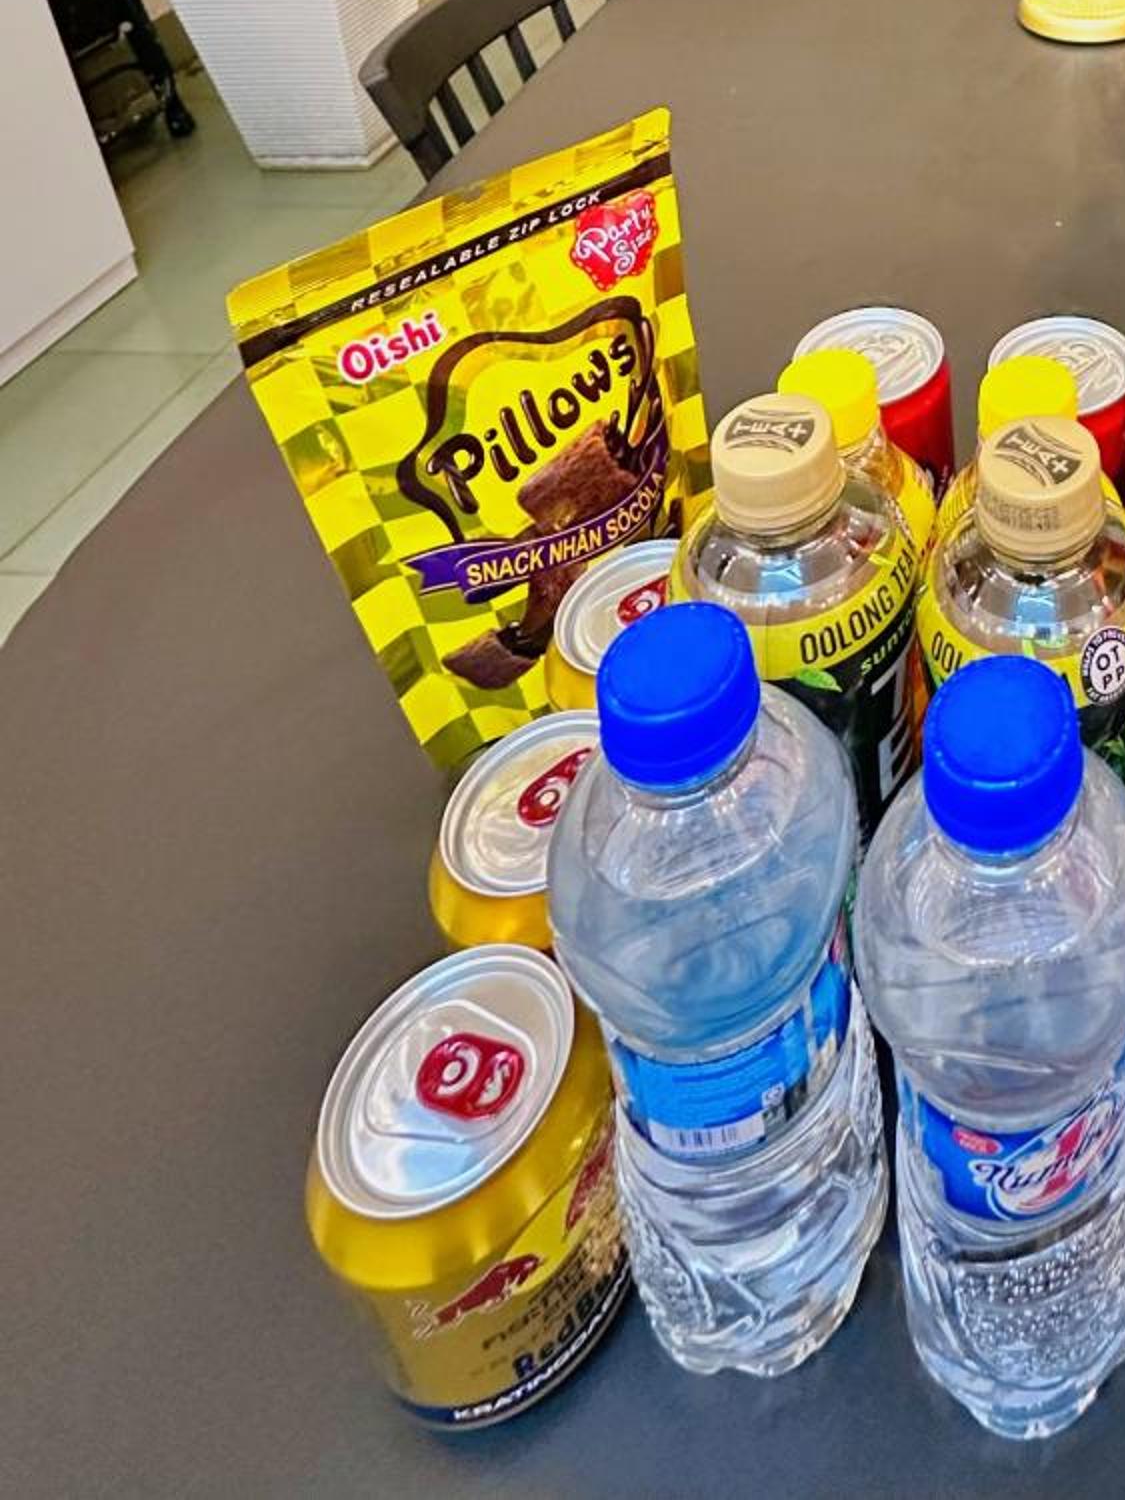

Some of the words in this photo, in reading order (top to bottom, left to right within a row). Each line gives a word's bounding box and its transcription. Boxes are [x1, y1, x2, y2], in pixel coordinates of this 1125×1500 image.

[351, 237, 500, 313] RESEALABLE
[508, 217, 542, 241] ZIP
[549, 190, 601, 224] LOCK
[576, 204, 652, 264] Party
[611, 228, 652, 276] Size
[341, 313, 442, 380] Oishi
[426, 334, 637, 514] Pillows
[466, 545, 544, 586] SNACK
[549, 526, 602, 564] NHÂN
[800, 585, 895, 665] OOLONG
